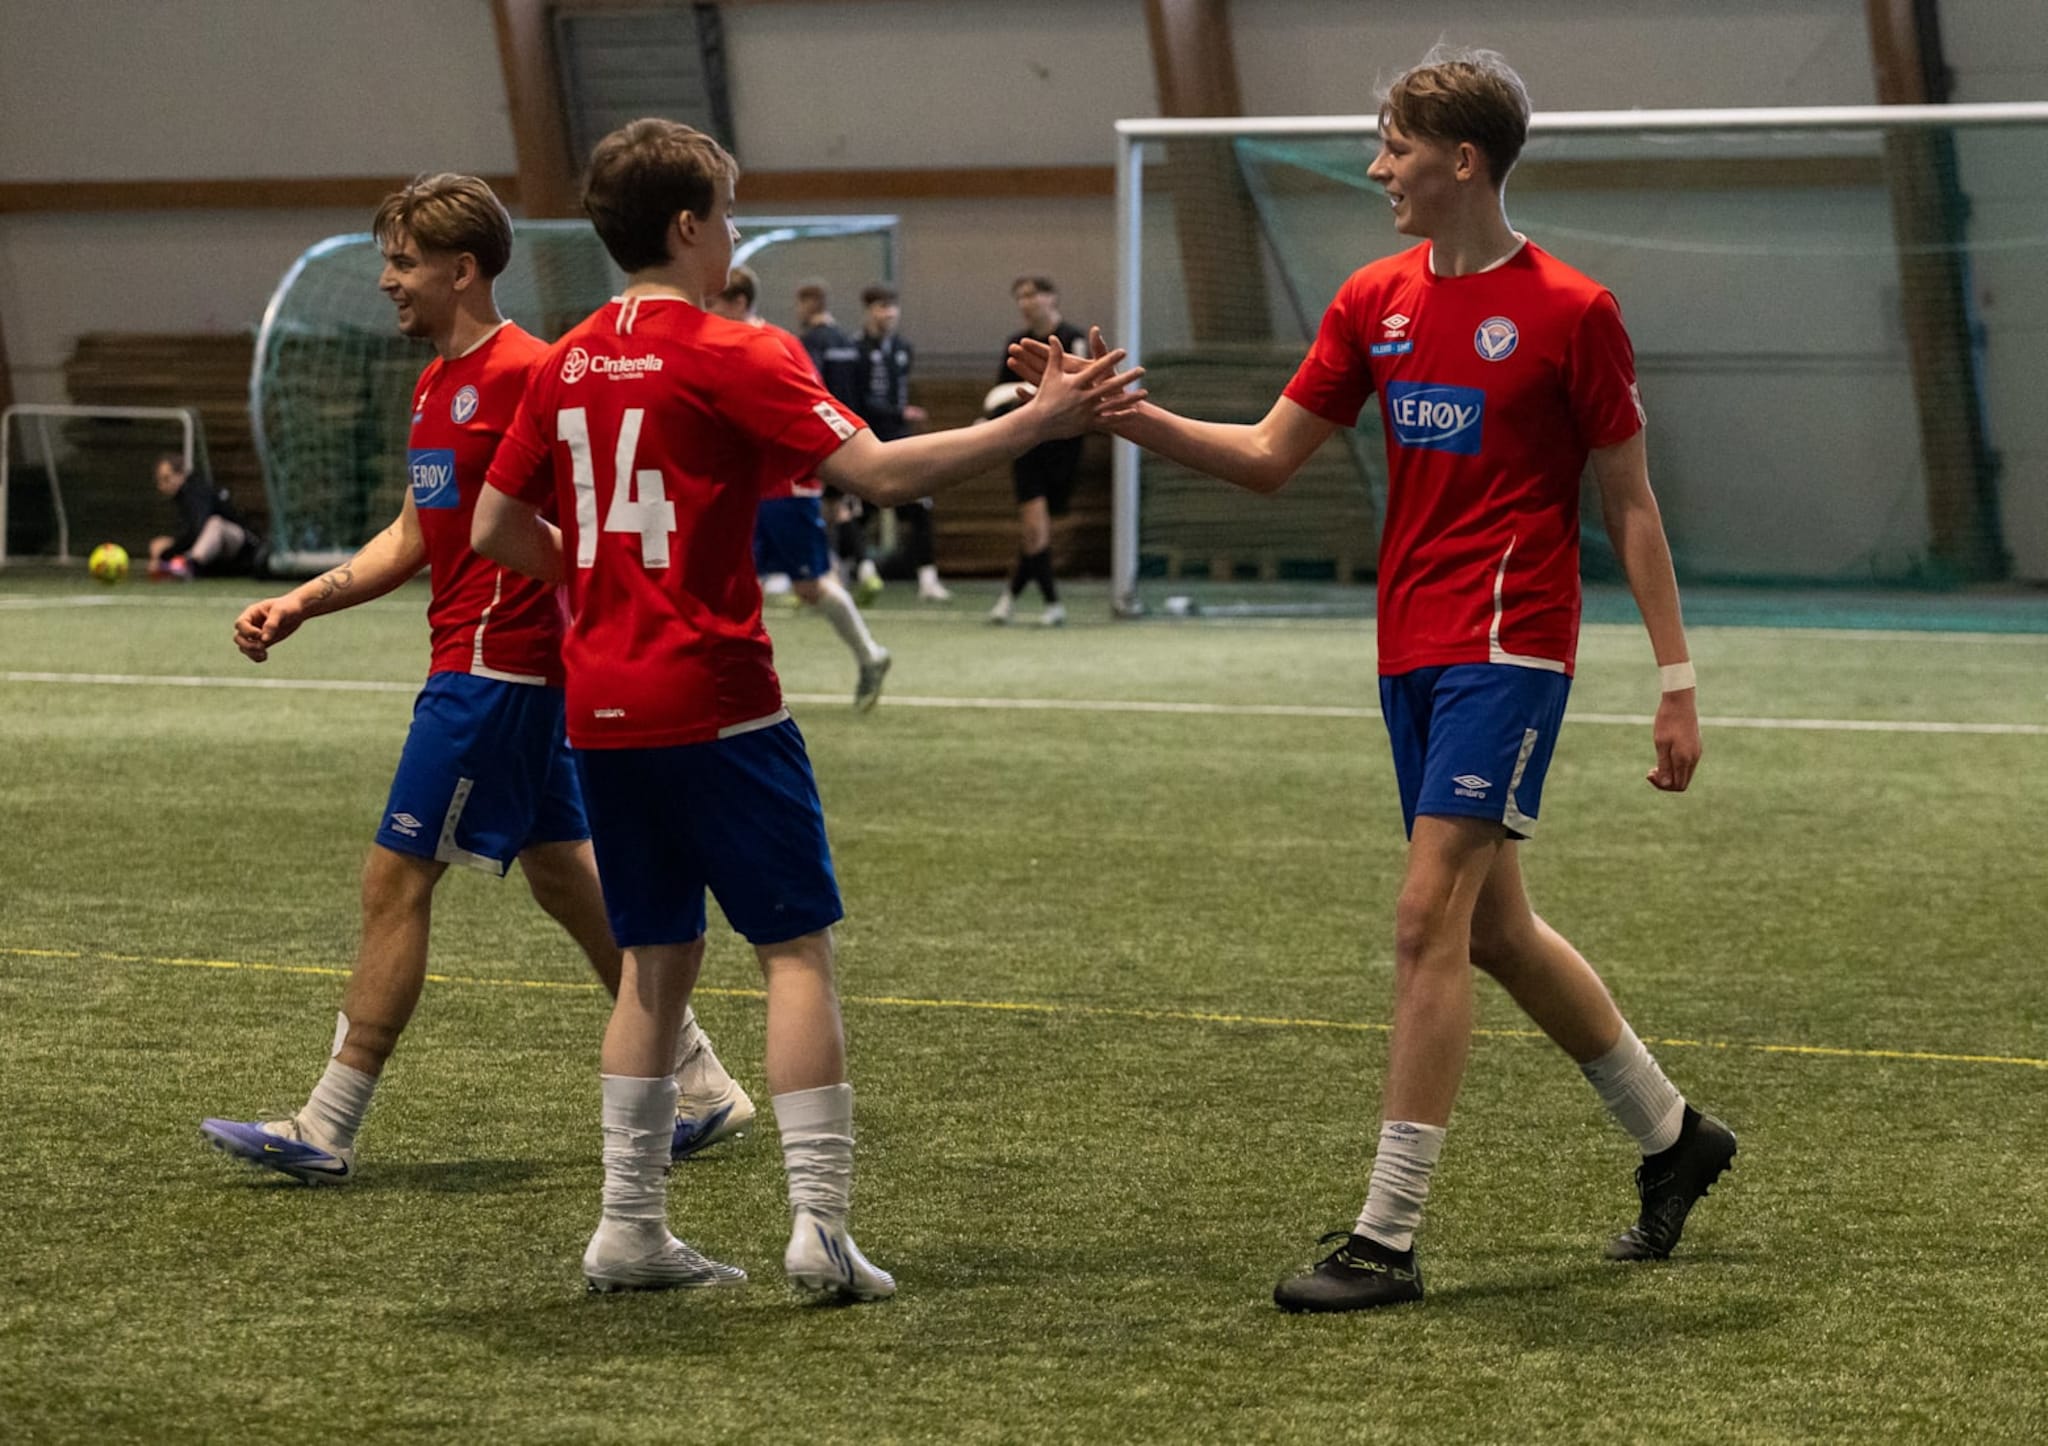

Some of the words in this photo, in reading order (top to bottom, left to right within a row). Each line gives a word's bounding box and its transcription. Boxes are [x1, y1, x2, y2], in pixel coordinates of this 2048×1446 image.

[590, 353, 663, 373] Cinderella
[1393, 398, 1473, 429] LERØY
[557, 407, 678, 568] 14
